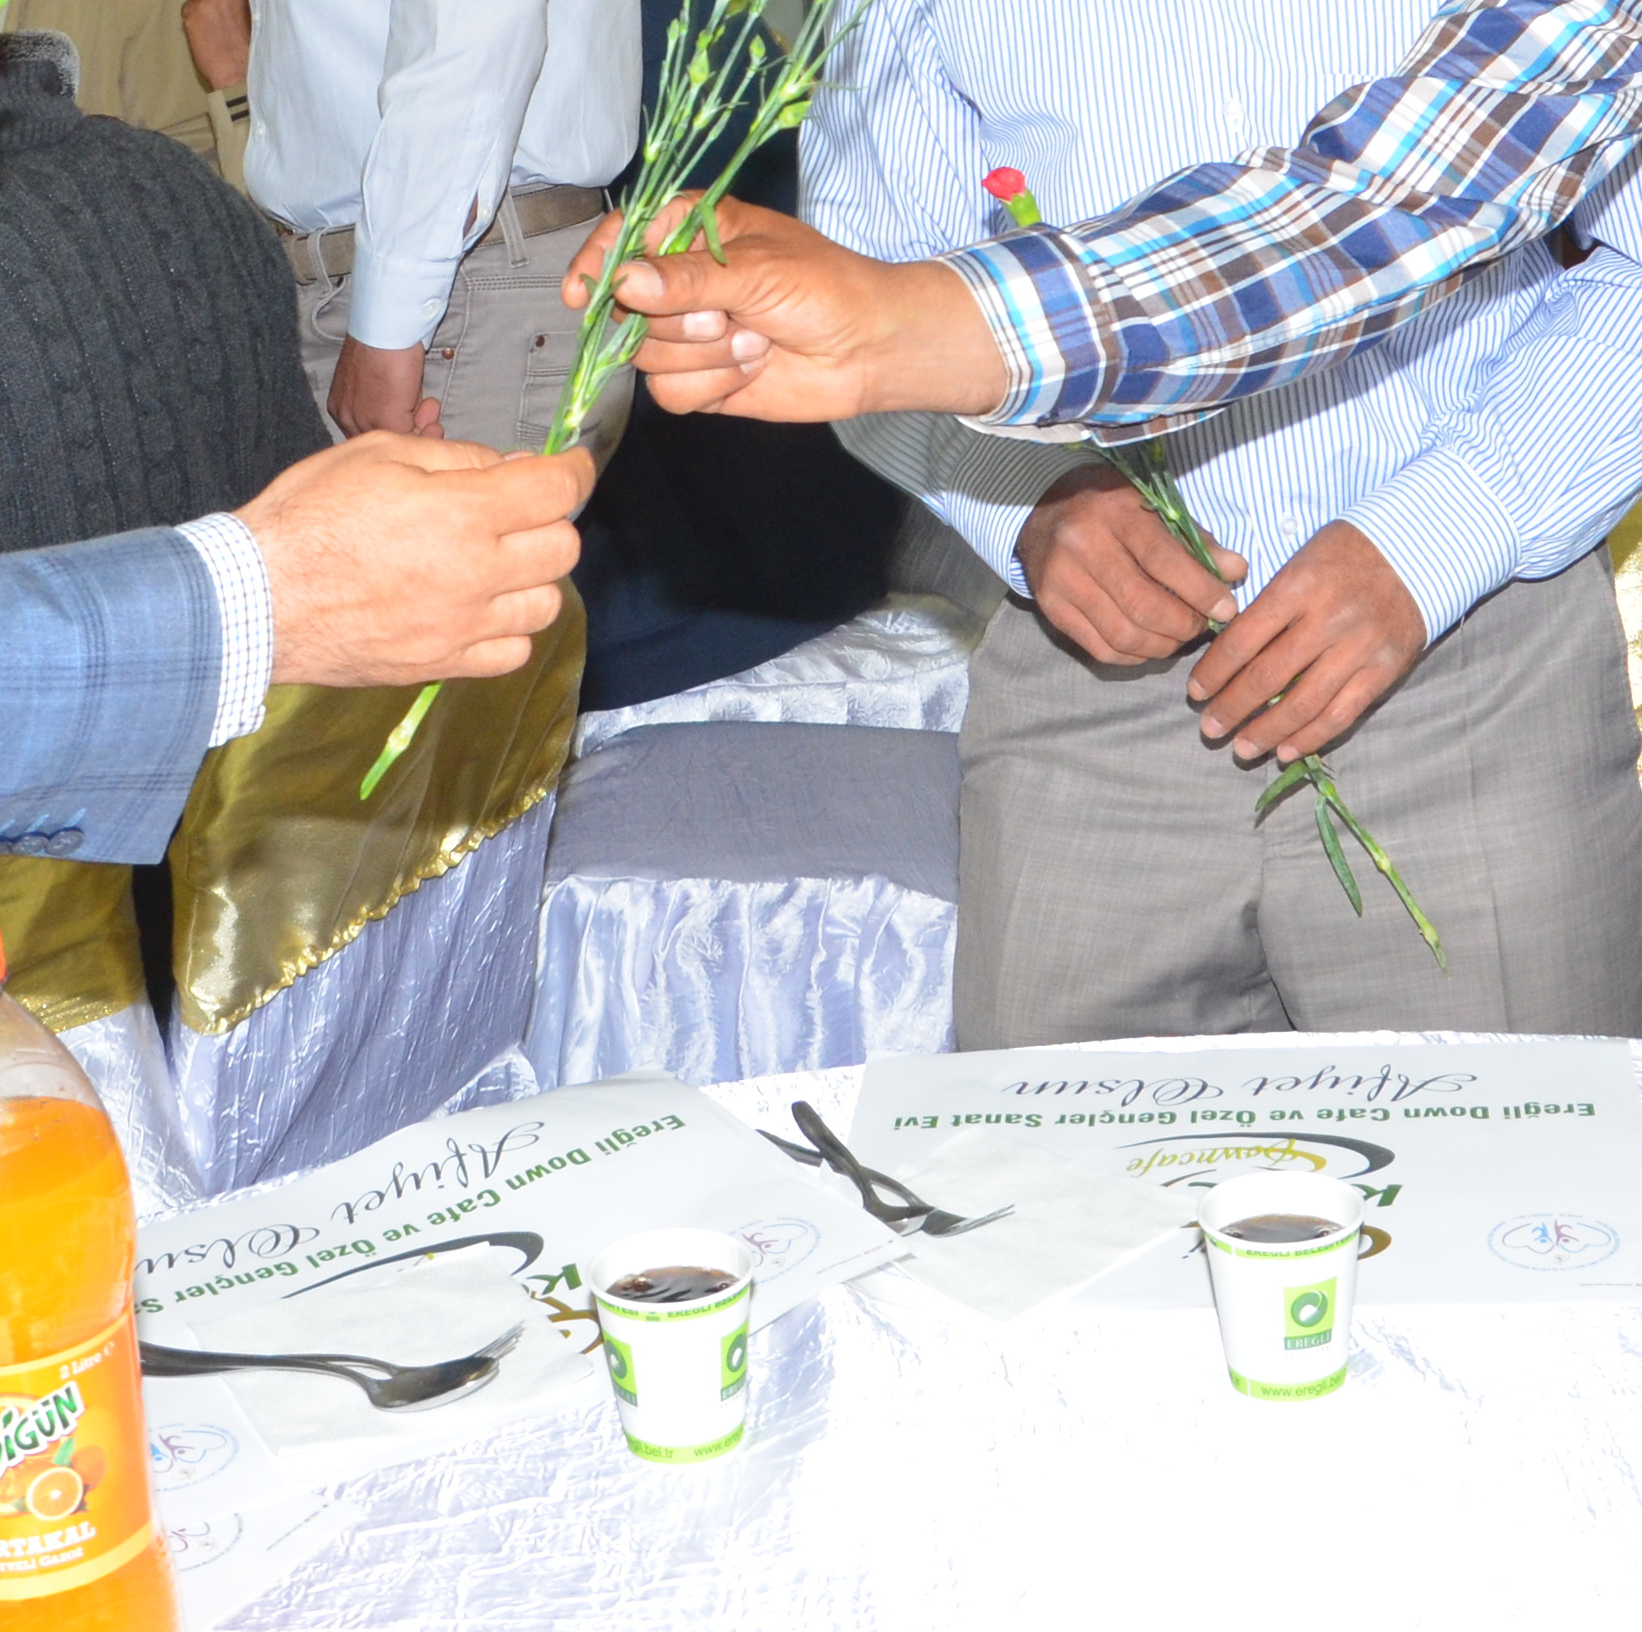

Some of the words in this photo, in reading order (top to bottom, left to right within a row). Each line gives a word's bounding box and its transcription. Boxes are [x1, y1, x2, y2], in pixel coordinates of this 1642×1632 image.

[1001, 1077, 1223, 1107] Olsun
[1241, 1064, 1477, 1102] Afiyet
[951, 1112, 1043, 1128] Sanat
[1055, 1109, 1177, 1126] Gençler
[1190, 1109, 1256, 1128] Özel
[1269, 1109, 1304, 1121] ve
[1317, 1107, 1390, 1122] Cafe
[1403, 1105, 1490, 1120] Down
[1503, 1103, 1595, 1120] Ereğli
[893, 1115, 939, 1131] Evi
[595, 1114, 686, 1155] Ereğli
[330, 1121, 545, 1225] Afiyet
[505, 1148, 592, 1190] Down
[427, 1188, 501, 1225] Cafe
[382, 1223, 420, 1243] ve
[135, 1224, 319, 1274] Olsu
[306, 1239, 376, 1268] Özel
[175, 1261, 298, 1303] Gençler
[72, 1353, 102, 1375] Litre
